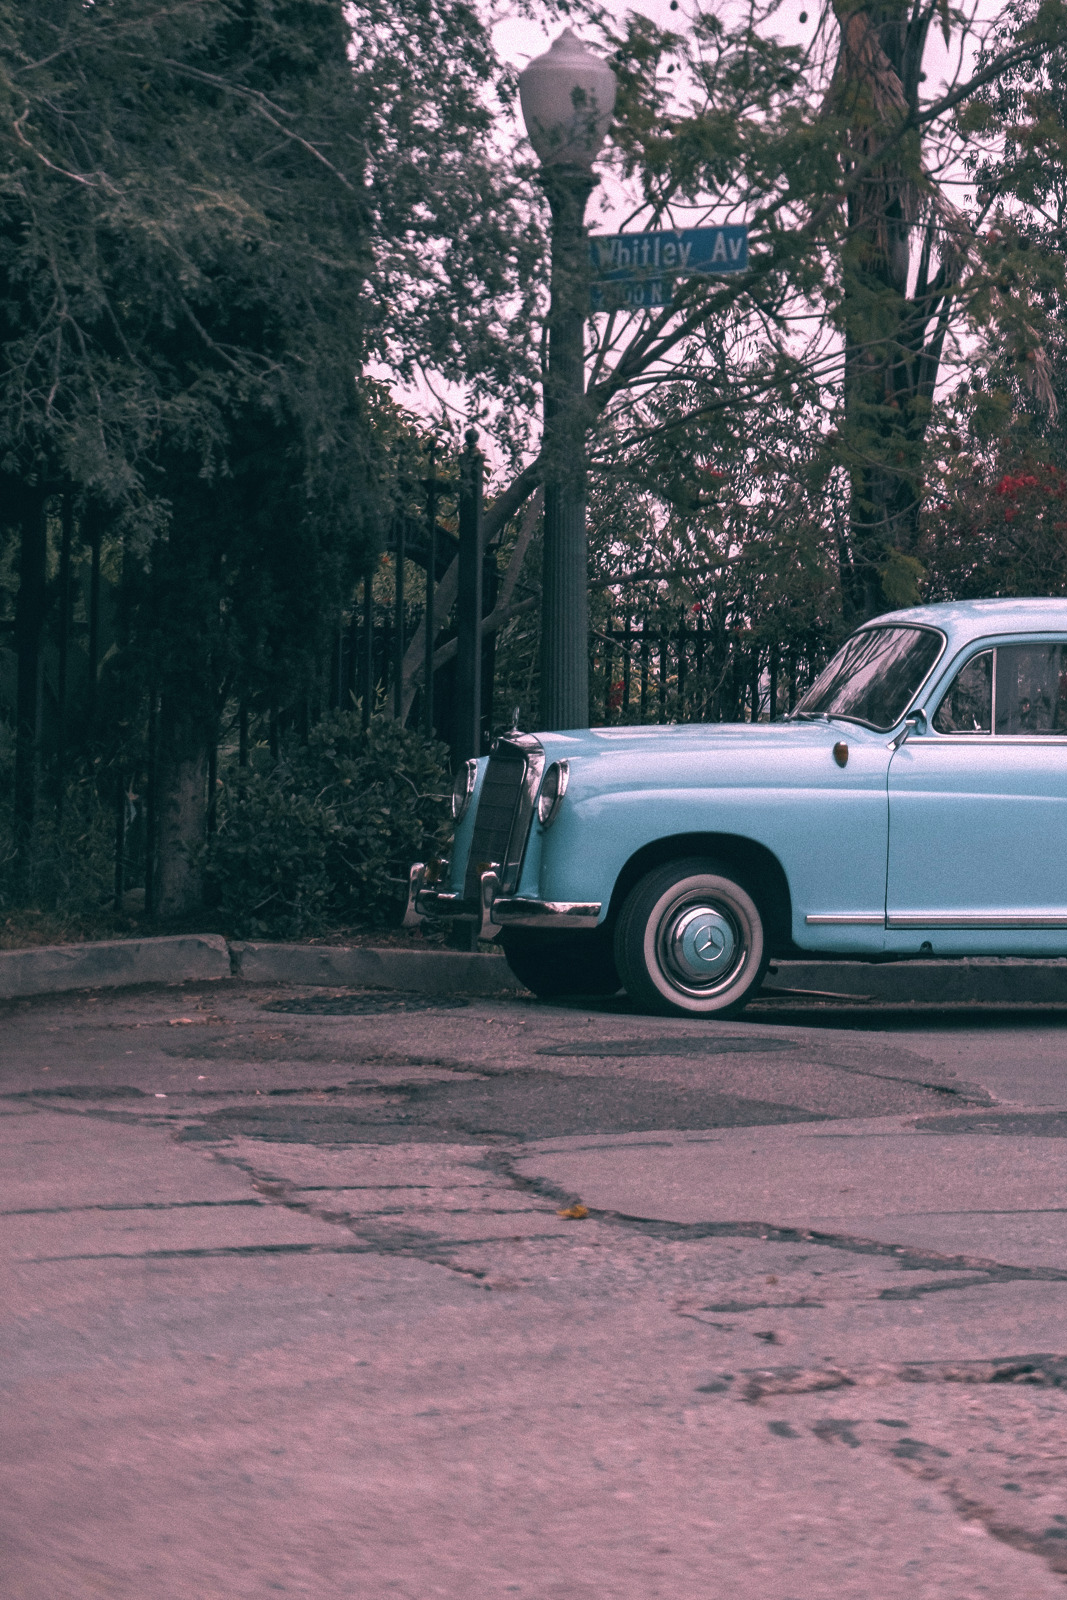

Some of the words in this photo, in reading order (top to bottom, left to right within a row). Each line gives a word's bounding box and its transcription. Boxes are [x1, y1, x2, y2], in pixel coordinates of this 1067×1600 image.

[597, 237, 692, 268] Whitley
[711, 232, 743, 262] Av
[651, 282, 663, 303] N
